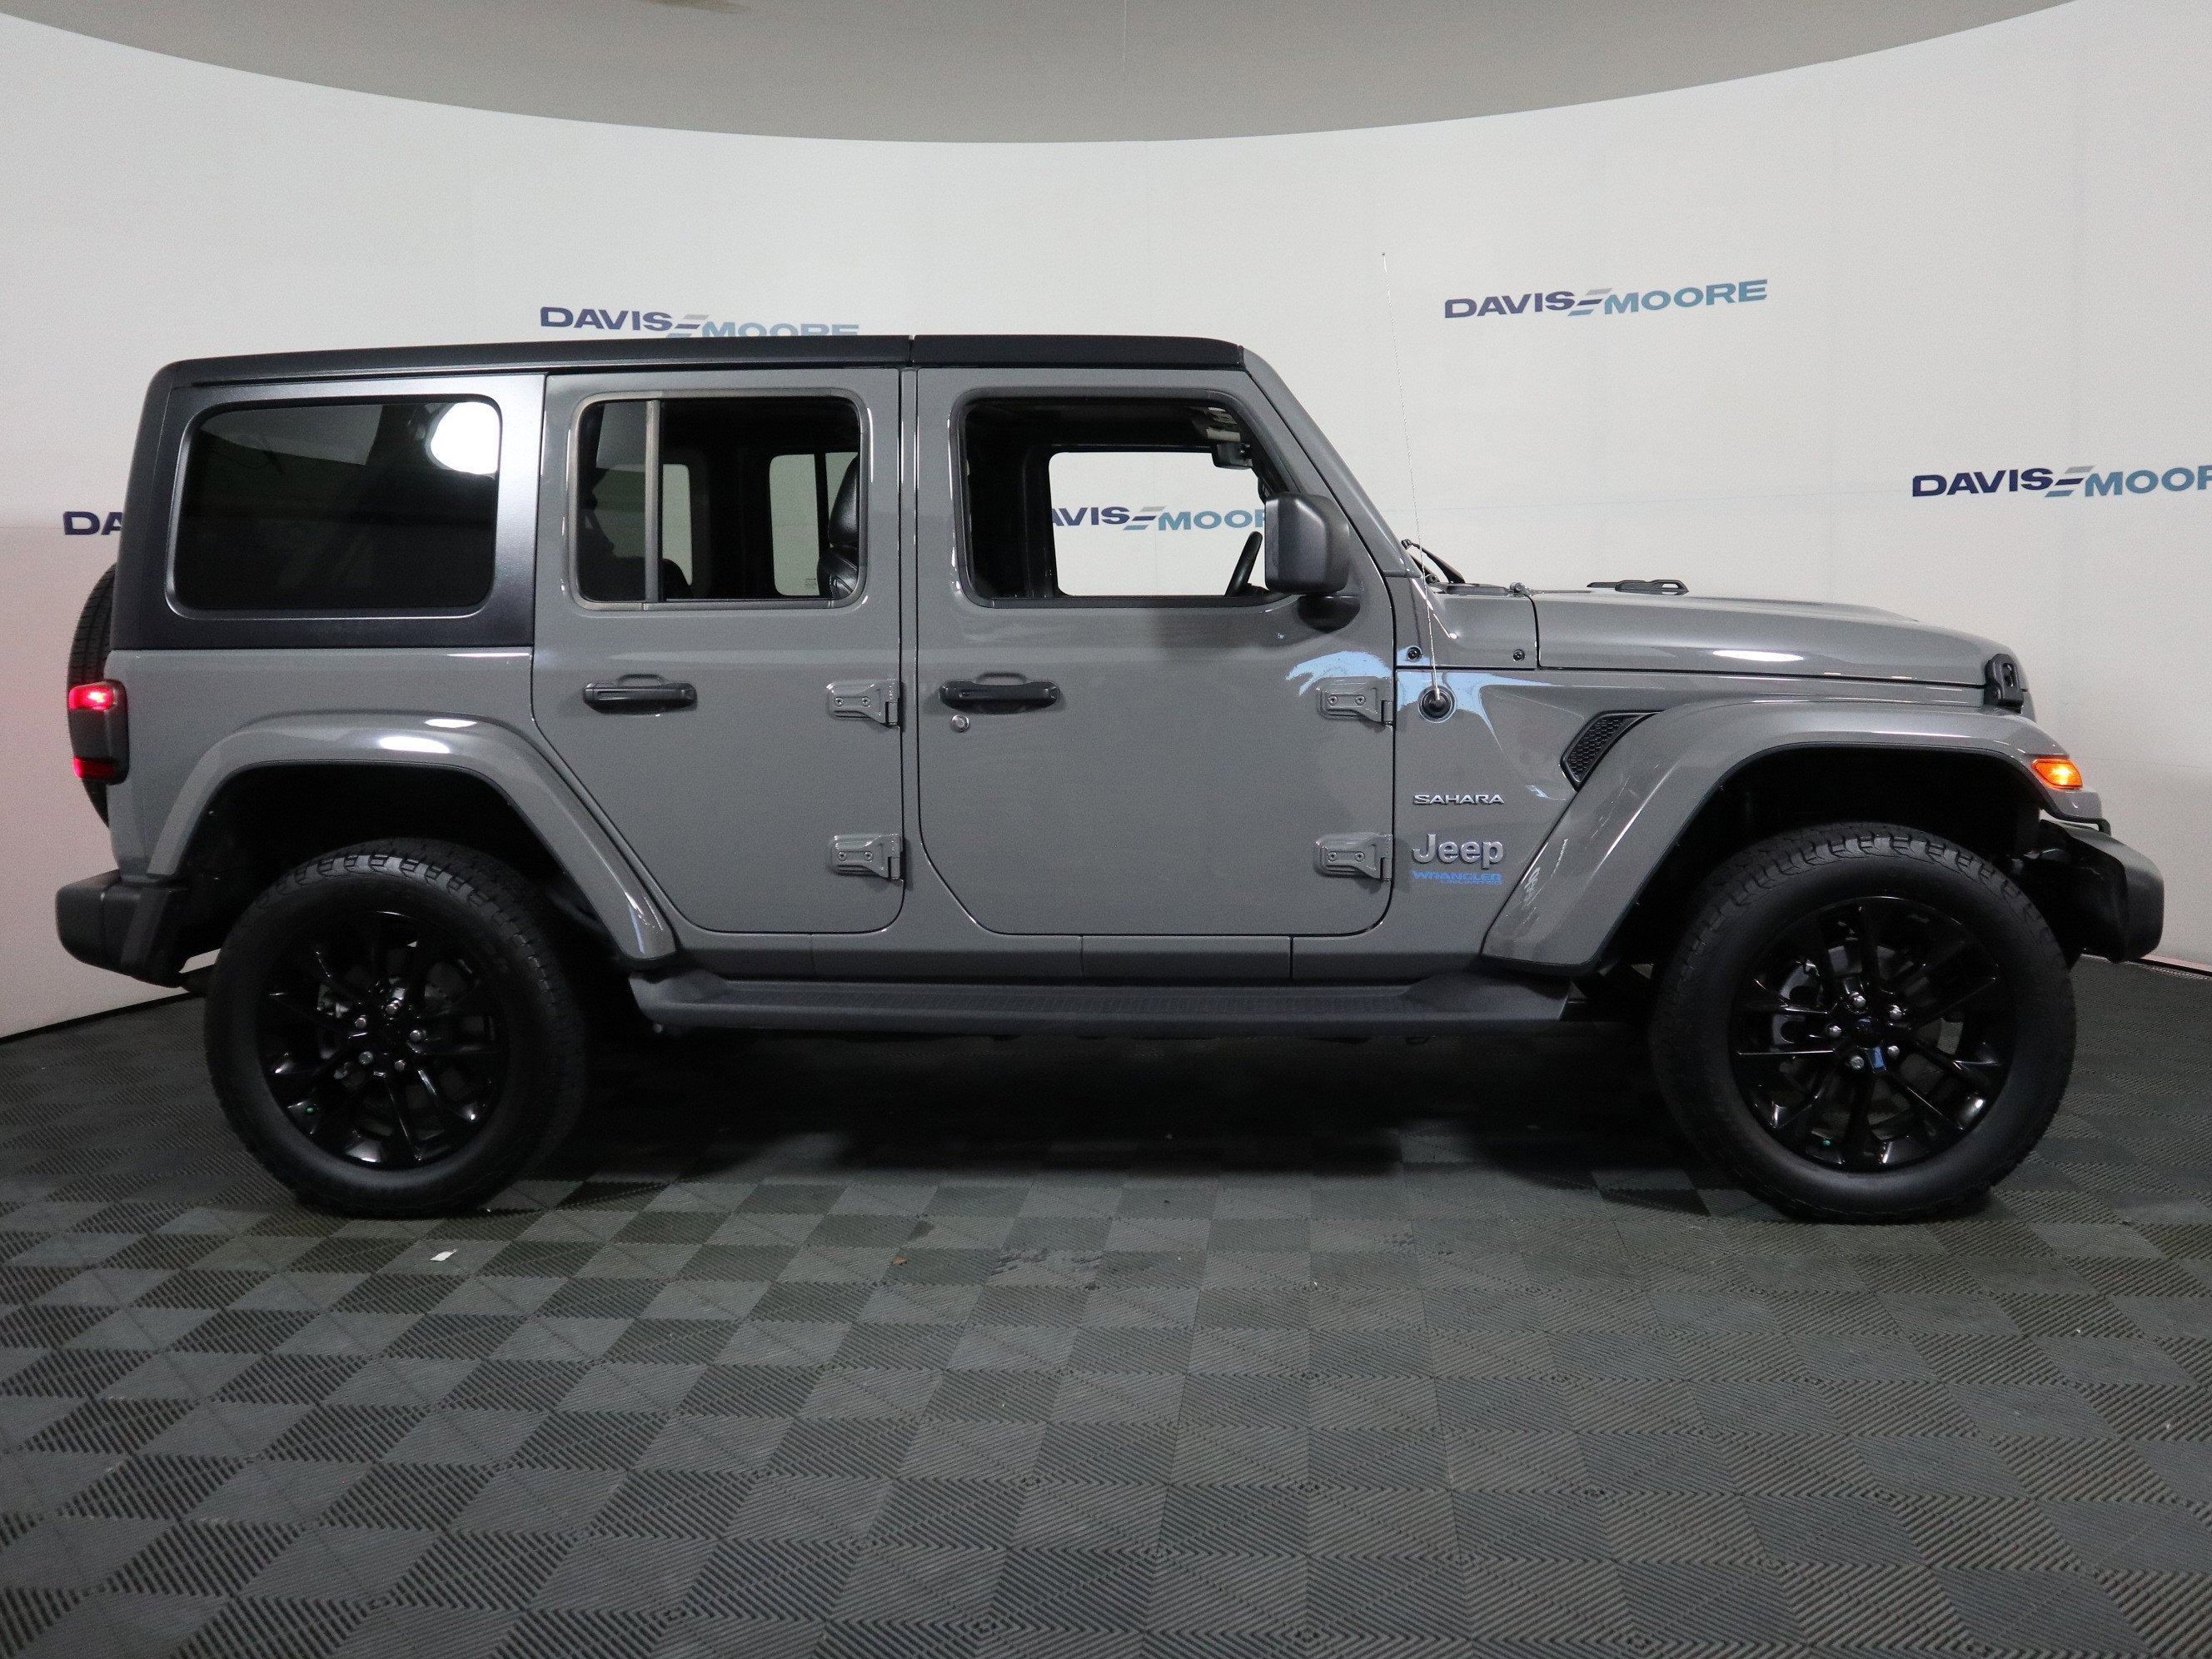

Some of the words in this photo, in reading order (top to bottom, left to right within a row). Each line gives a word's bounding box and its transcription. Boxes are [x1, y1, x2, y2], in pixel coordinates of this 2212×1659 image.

[1444, 291, 1576, 318] DAVIS
[1604, 278, 1768, 315] MOORE
[540, 306, 672, 331] DAVIS
[1912, 467, 2053, 497] DAVIS
[1413, 794, 1505, 805] SAHARA
[1412, 834, 1504, 869] Jeep
[1412, 870, 1502, 880] WRANGLER
